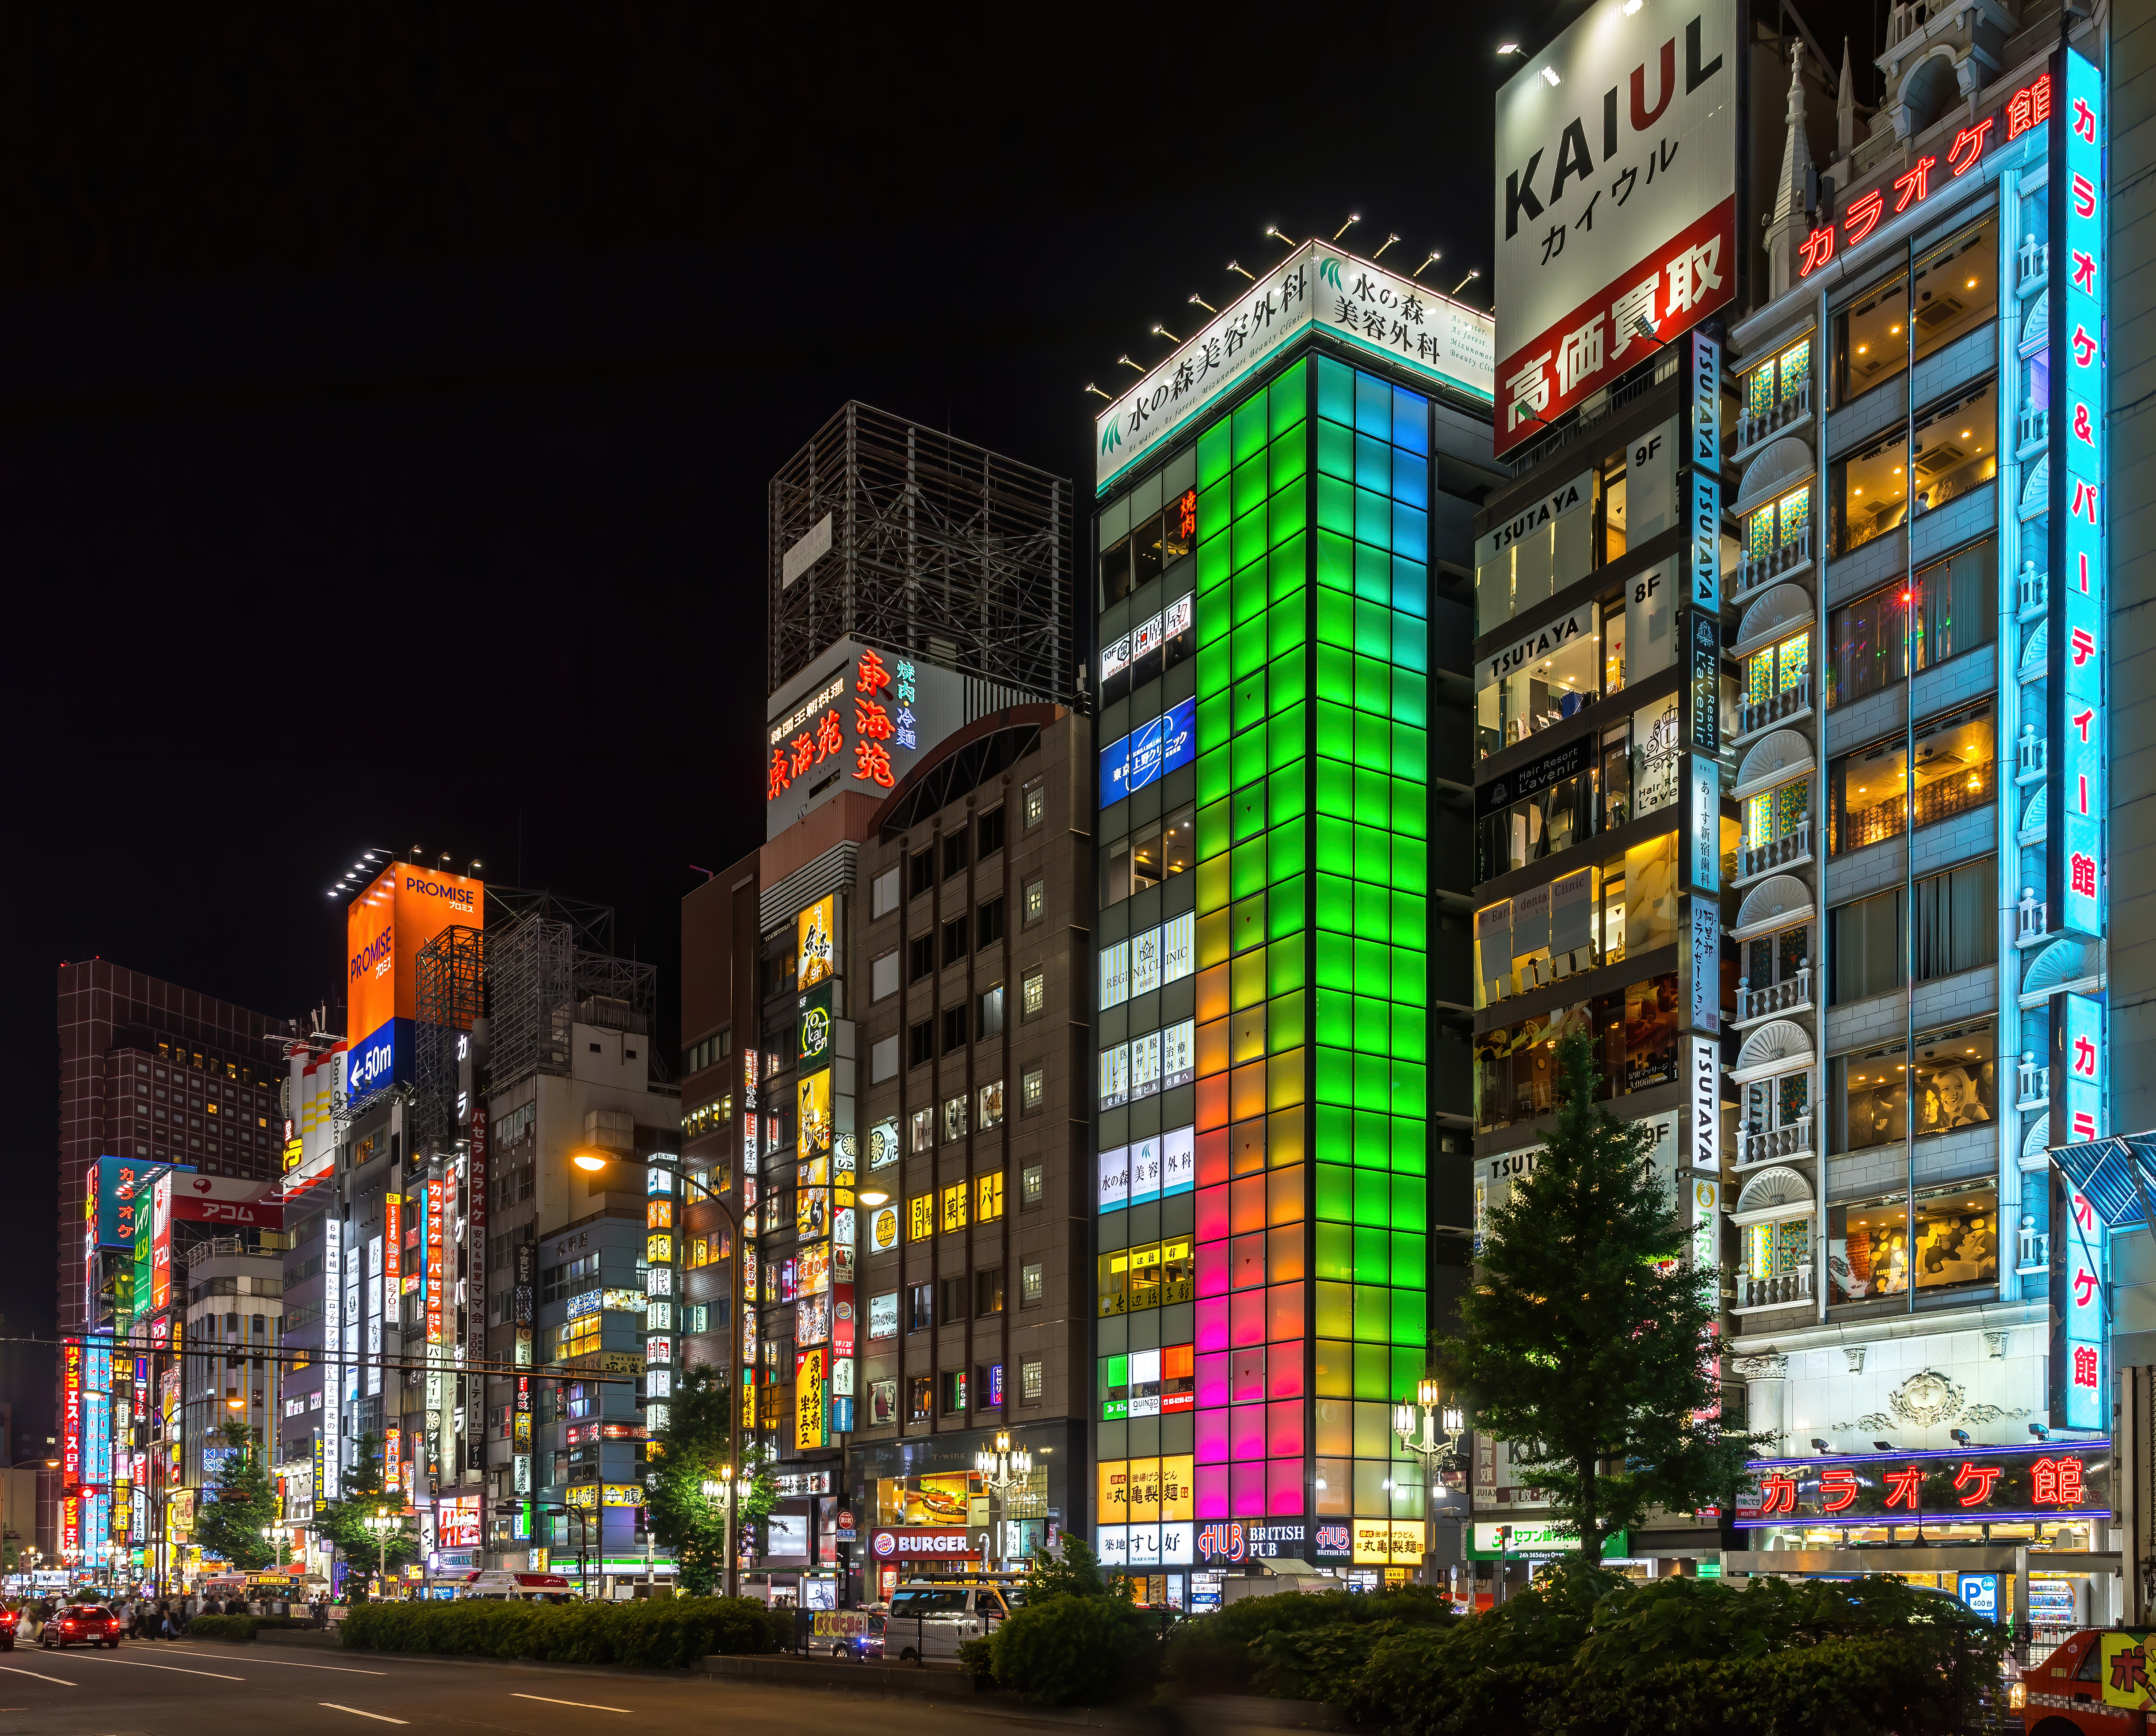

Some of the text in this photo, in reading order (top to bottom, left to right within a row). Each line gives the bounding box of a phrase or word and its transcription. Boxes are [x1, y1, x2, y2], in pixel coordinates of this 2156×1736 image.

[1506, 14, 1722, 242] KAIUL
[1799, 73, 2051, 277] カラオケ館
[1542, 137, 1679, 266] カイウル
[1352, 273, 1425, 326] 水の森
[1333, 295, 1441, 365] 美容外科
[1450, 313, 1460, 324] As
[1450, 325, 1460, 336] As
[1506, 234, 1723, 432] 高価買取
[1127, 263, 1308, 433] 水の森美容外科
[1201, 310, 1305, 398] Mizunomori Beauty Clinic
[1450, 349, 1477, 368] Beauty
[1698, 345, 1713, 459] TSUTAYA
[1635, 435, 1662, 468] 9F
[1180, 491, 1197, 539] 焼肉
[1493, 486, 1580, 551] TSUTAYA
[1698, 485, 1713, 599] TSUTAYA
[1635, 573, 1662, 604] 8F
[1103, 647, 1117, 662] 10F
[1492, 617, 1579, 677] TSUTAYA
[771, 678, 844, 746] 韓国王朝料理
[853, 648, 895, 788] 東海苑
[768, 709, 843, 801] 東海苑
[1113, 730, 1188, 783] 東京上野クリニック
[1519, 747, 1578, 782] Hair Resort
[1639, 780, 1660, 799] Hair
[1700, 780, 1711, 888] あーす新宿歯科
[406, 877, 473, 904] PROMISE
[448, 900, 473, 913] プロミス
[1492, 897, 1517, 923] Earth
[1520, 886, 1550, 910] dental
[1554, 876, 1585, 897] Clinic
[351, 925, 392, 984] PROMISE
[375, 956, 391, 980] プロミス
[1106, 946, 1188, 990] REGINA CLINIC
[1694, 908, 1703, 1017] リラクゼーション
[811, 965, 822, 980] 9F
[799, 997, 807, 1007] 8F
[365, 1043, 391, 1081] 50m
[1698, 1047, 1712, 1162] TSUTAYA
[885, 1138, 897, 1147] Darts
[1101, 1151, 1192, 1192] 水の森美容外科
[135, 1202, 150, 1236] レイク
[202, 1202, 254, 1222] アコム
[154, 1244, 169, 1270] アコム
[428, 1184, 442, 1308] カラオケ パセラ
[158, 1291, 164, 1306] 3F
[872, 1298, 879, 1307] 4F
[428, 1431, 439, 1462] ダーツ
[932, 1452, 966, 1461] T-wing
[387, 1454, 399, 1474] 麻雀
[518, 1457, 528, 1490] 水野屋酒店
[1131, 1470, 1178, 1483] 釜揚げうどん
[1760, 1456, 2084, 1514] カラオケ館
[876, 1537, 893, 1545] BURGER
[878, 1542, 893, 1551] KING
[899, 1536, 970, 1552] BURGER
[1105, 1533, 1180, 1553] 築地 すし好
[1198, 1523, 1244, 1562] HUB
[1249, 1526, 1305, 1542] BRITISH
[1249, 1543, 1277, 1557] PUB
[1316, 1527, 1350, 1549] HUB
[1965, 1583, 1981, 1607] P
